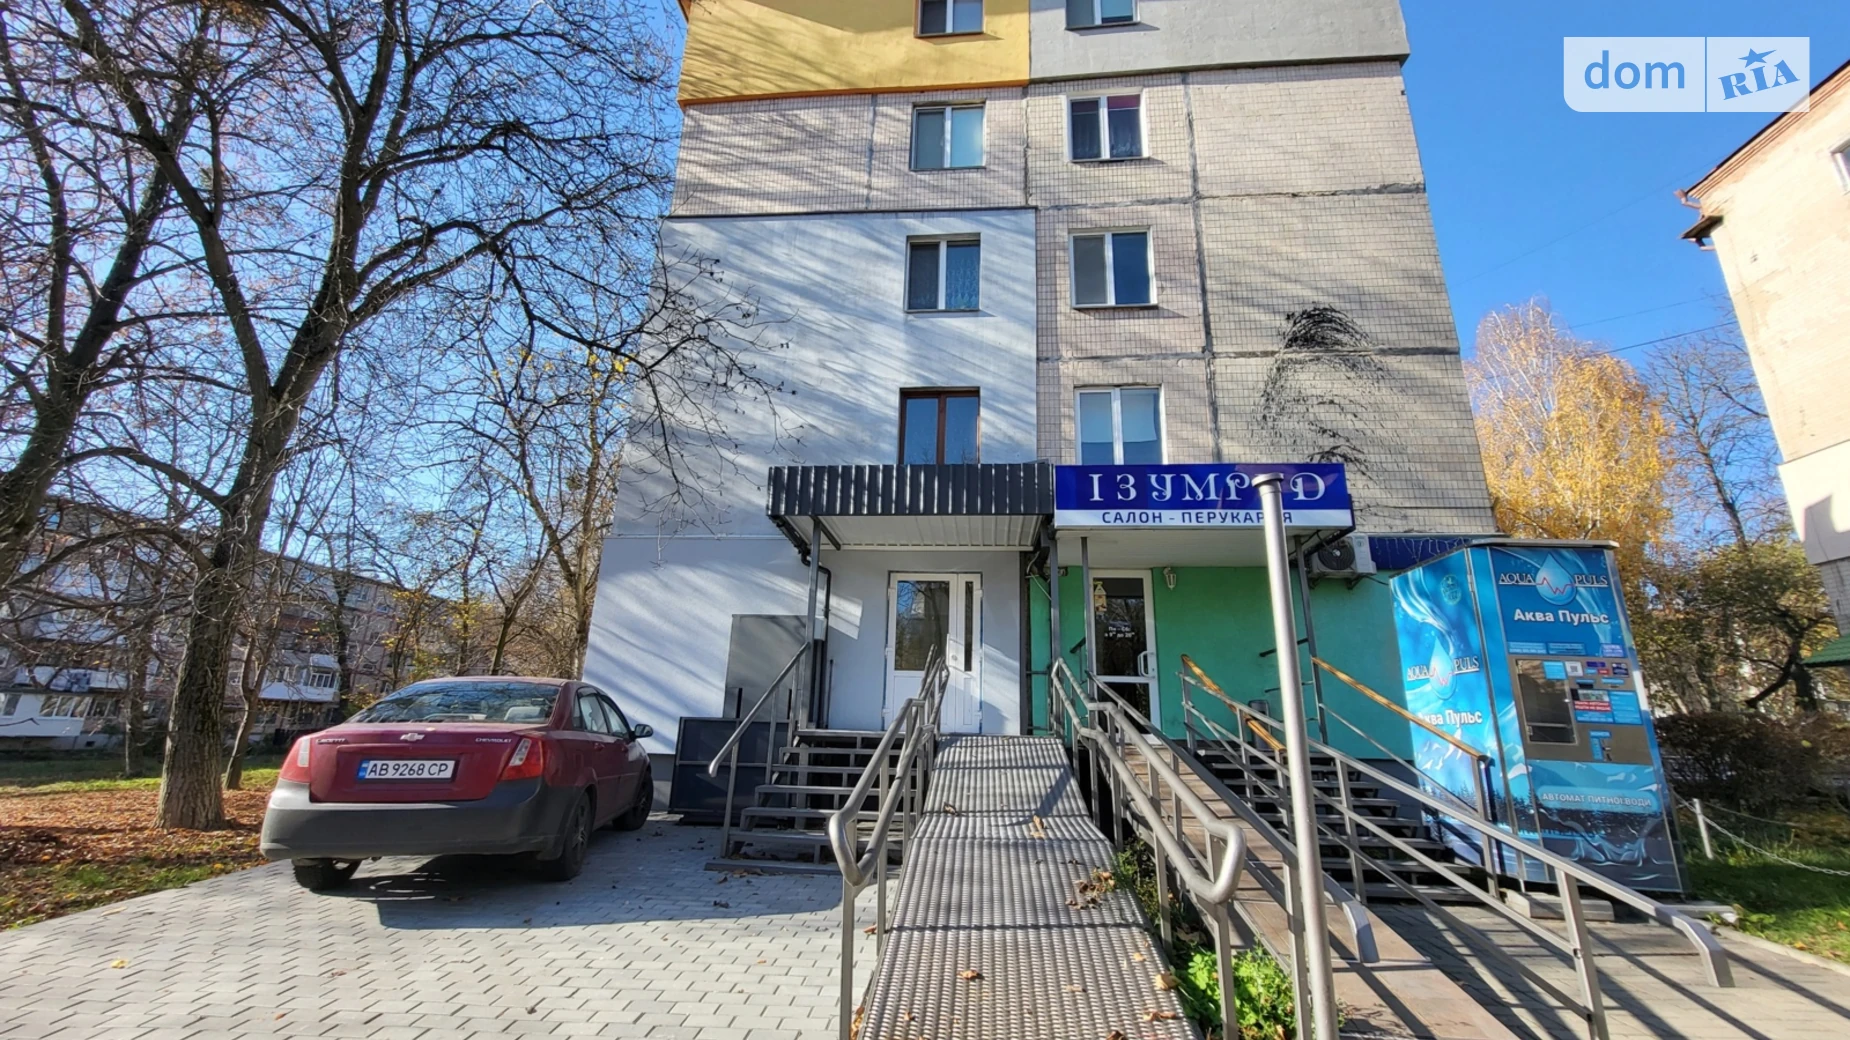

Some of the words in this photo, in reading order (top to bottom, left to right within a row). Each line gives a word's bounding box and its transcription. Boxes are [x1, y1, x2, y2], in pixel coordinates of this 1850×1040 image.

[1102, 511, 1163, 524] САЛОН
[1182, 511, 1293, 524] ПЕРУКАРЯ
[1499, 573, 1535, 585] AQUA
[1574, 574, 1608, 585] PULS
[1514, 608, 1555, 622] Аква
[1558, 609, 1610, 626] Пульс
[1407, 665, 1428, 680] AQUA
[1454, 656, 1480, 672] PULS
[1445, 709, 1483, 728] Пульс
[368, 763, 390, 776] AB
[392, 763, 425, 776] 9268
[428, 763, 449, 776] CP
[1542, 793, 1585, 802] АВТОМАТ
[1625, 797, 1652, 807] ВОДИ
